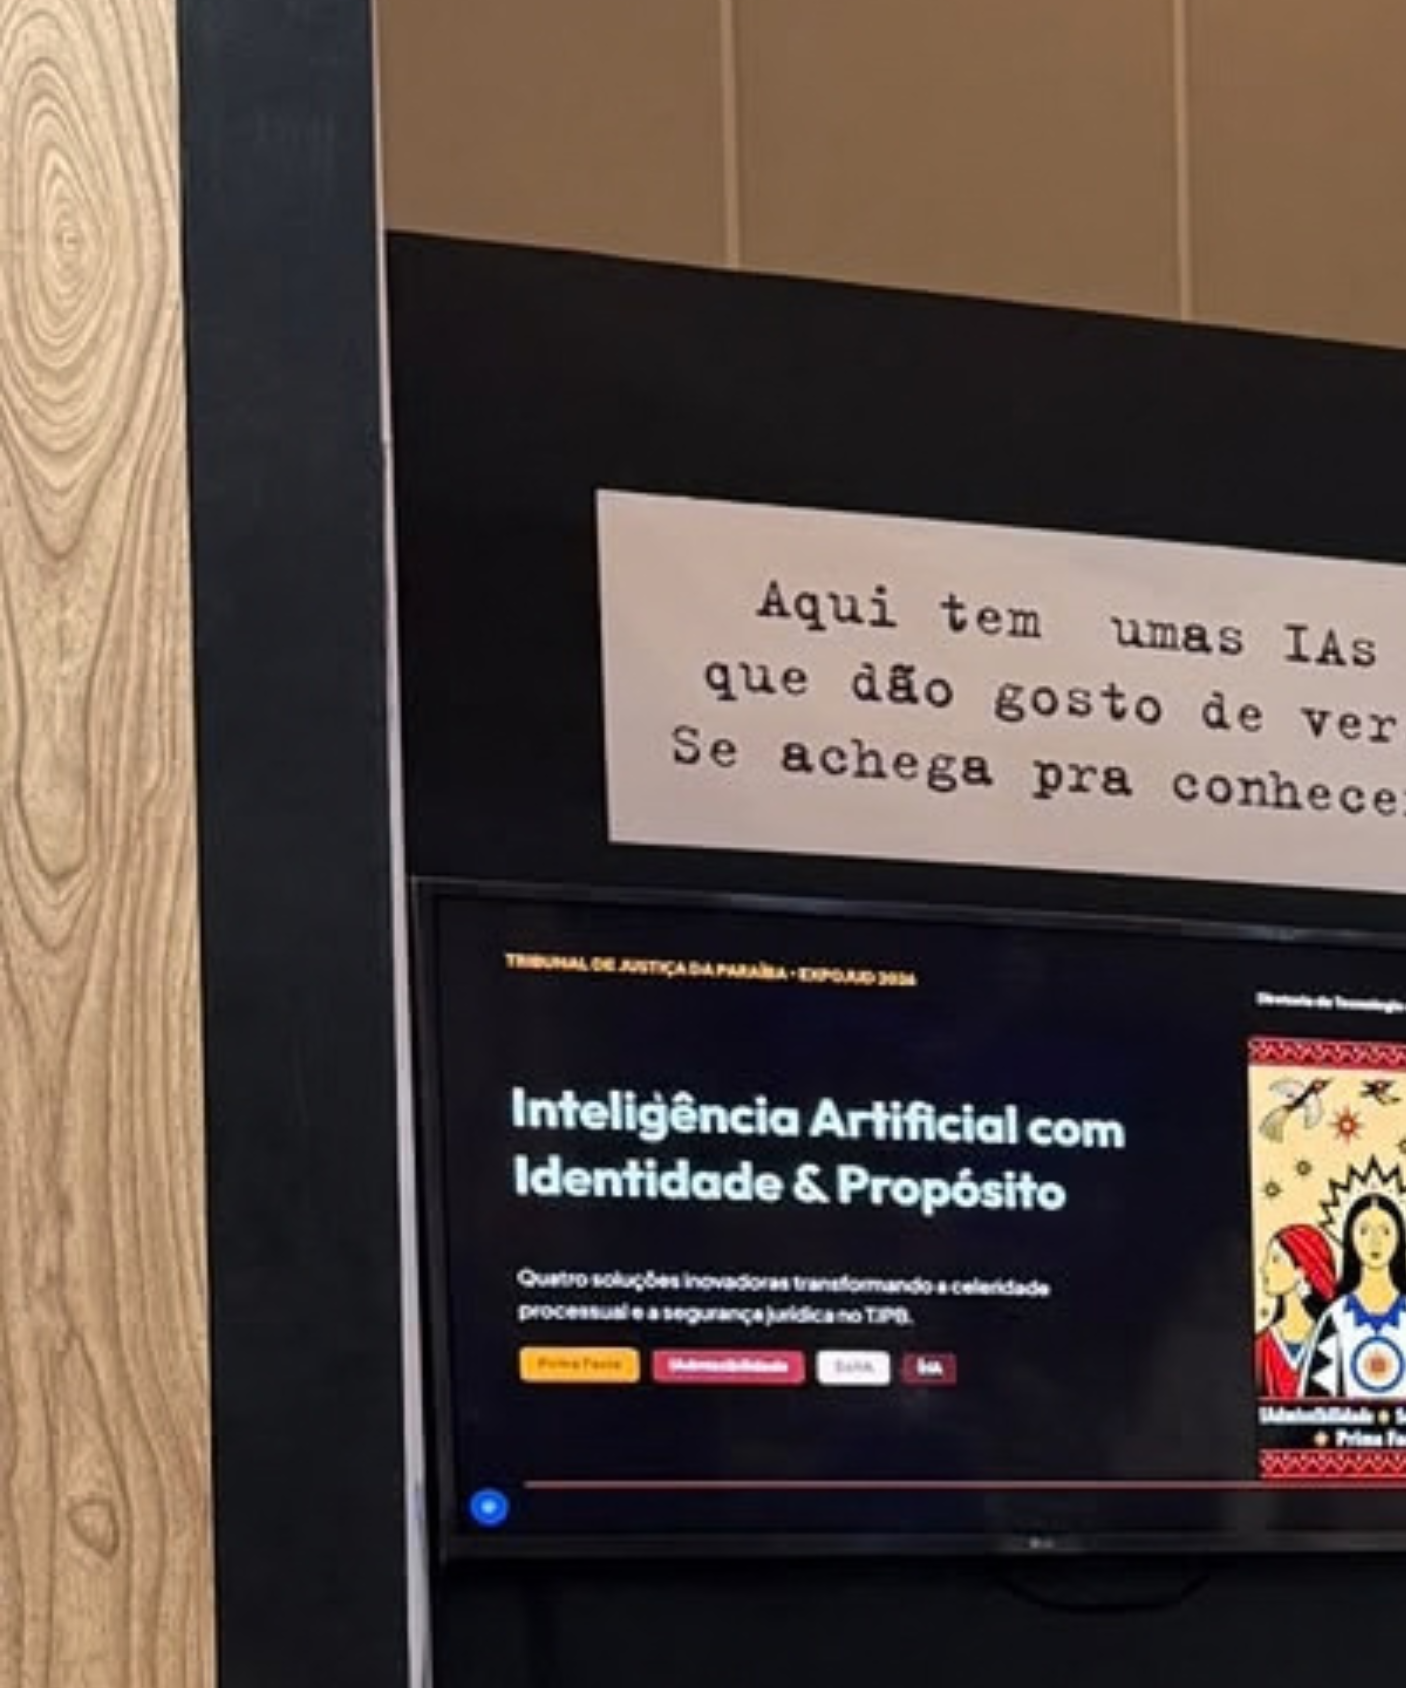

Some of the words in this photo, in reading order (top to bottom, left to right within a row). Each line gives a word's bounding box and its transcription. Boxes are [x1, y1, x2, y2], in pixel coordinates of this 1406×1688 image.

[755, 579, 897, 630] Aqui
[940, 591, 1043, 640] tem
[1111, 614, 1246, 659] umas
[1286, 622, 1377, 670] IAs
[704, 655, 808, 701] que
[851, 660, 954, 710] dão
[993, 678, 1164, 726] gosto
[1201, 691, 1265, 735] de
[671, 724, 738, 767] Se
[780, 738, 993, 793] achega
[1031, 758, 1132, 800] pra
[505, 953, 589, 972] TRIBUNAL
[591, 956, 615, 972] DE
[618, 959, 687, 978] JUSTIÇA
[688, 961, 714, 976] DA
[716, 961, 788, 979] PARAÍBA
[512, 1086, 799, 1142] Inteligência
[810, 1098, 1017, 1145] Artificial
[1027, 1115, 1126, 1148] com
[514, 1155, 784, 1202] Identidade
[793, 1166, 829, 1204] &
[837, 1163, 1066, 1217] Propósito
[517, 1269, 588, 1288] Quatro
[591, 1270, 680, 1291] soluções
[683, 1272, 789, 1291] inovadoras
[793, 1274, 933, 1294] transformando
[937, 1280, 947, 1293] a
[951, 1277, 1050, 1296] celeridade
[519, 1302, 628, 1322] processual
[632, 1307, 644, 1320] e
[647, 1307, 659, 1320] a
[662, 1306, 763, 1326] segurança
[765, 1303, 834, 1327] jurídica
[837, 1309, 862, 1324] no
